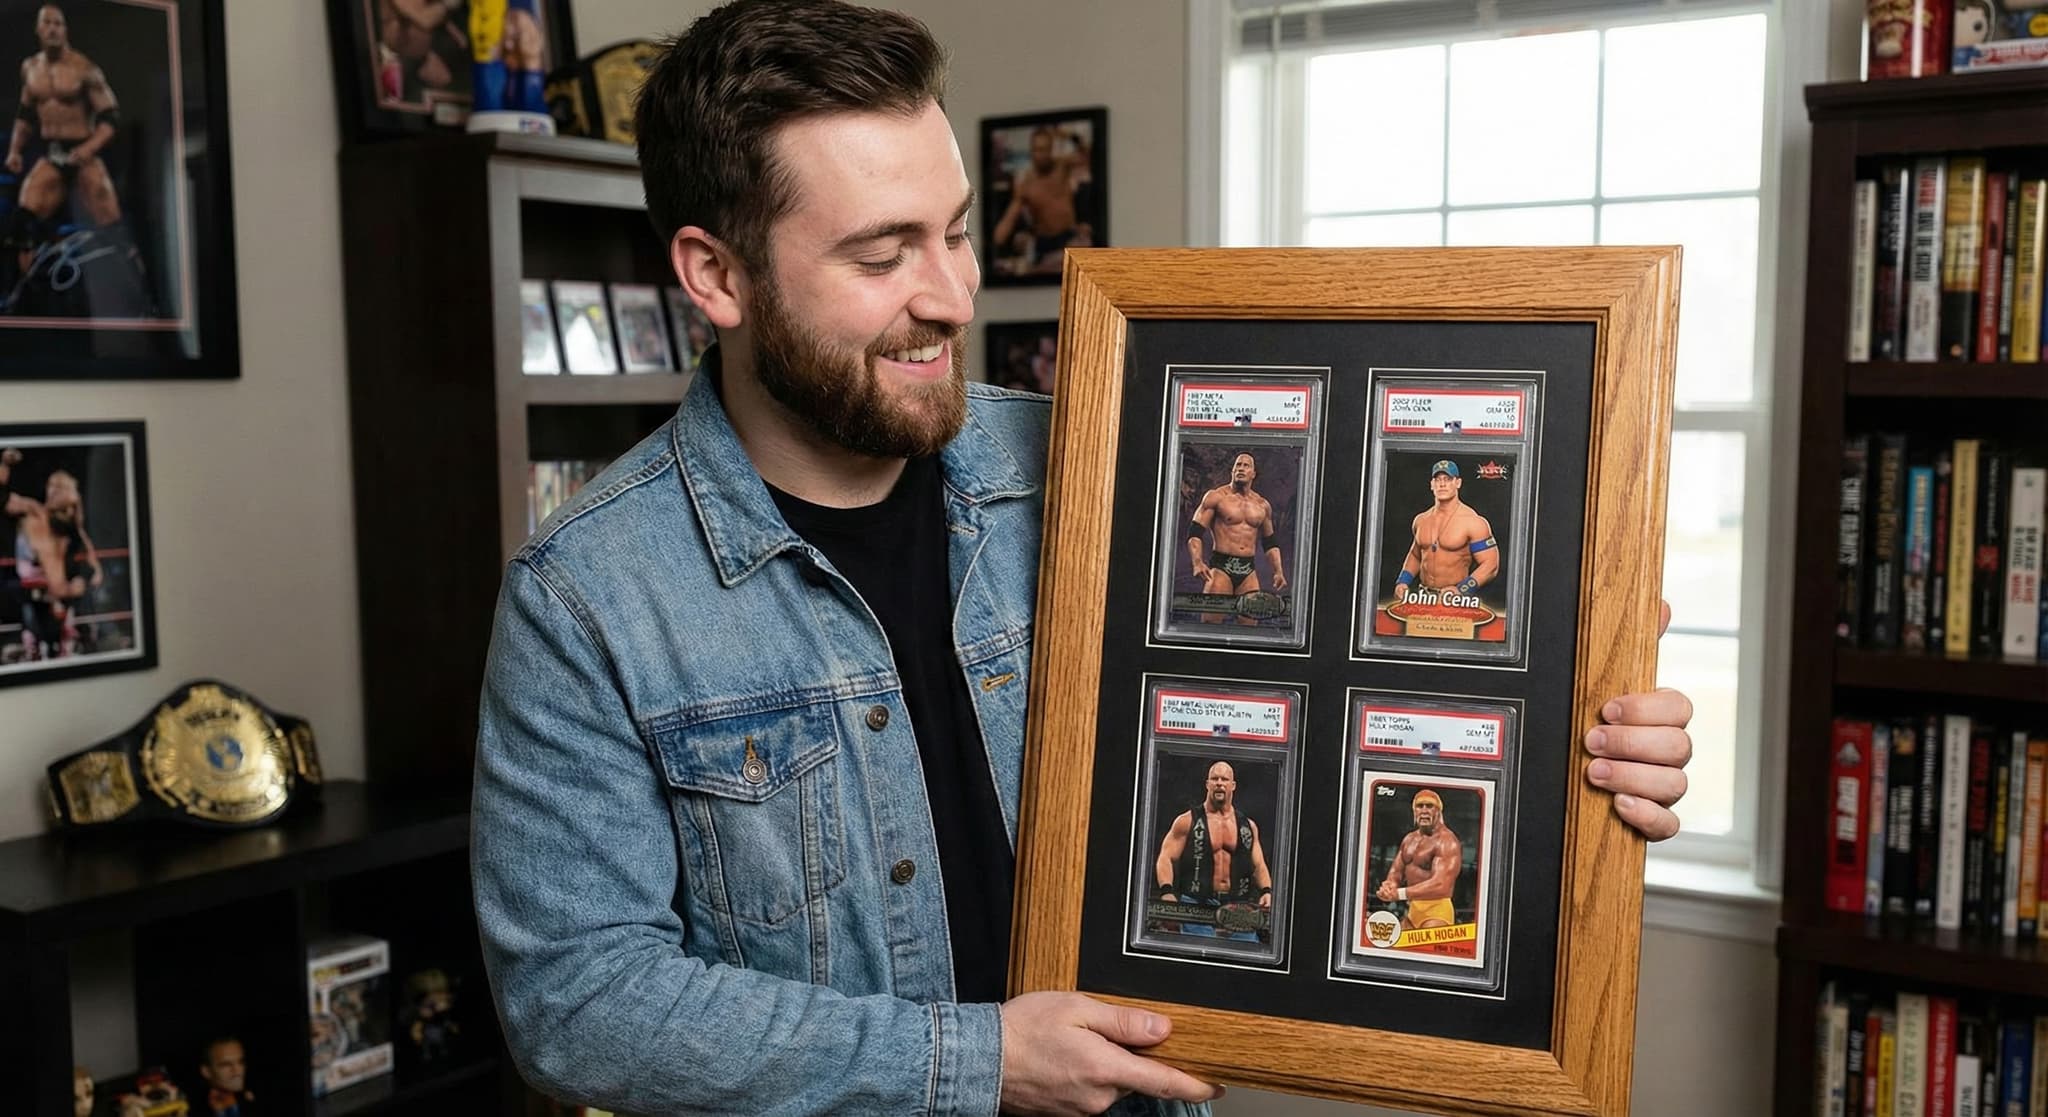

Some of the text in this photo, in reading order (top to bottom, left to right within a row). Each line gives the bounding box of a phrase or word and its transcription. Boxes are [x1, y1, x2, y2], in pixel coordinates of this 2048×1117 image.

[1402, 589, 1480, 608] John Cena
[1407, 927, 1467, 944] HULK HOGAN
